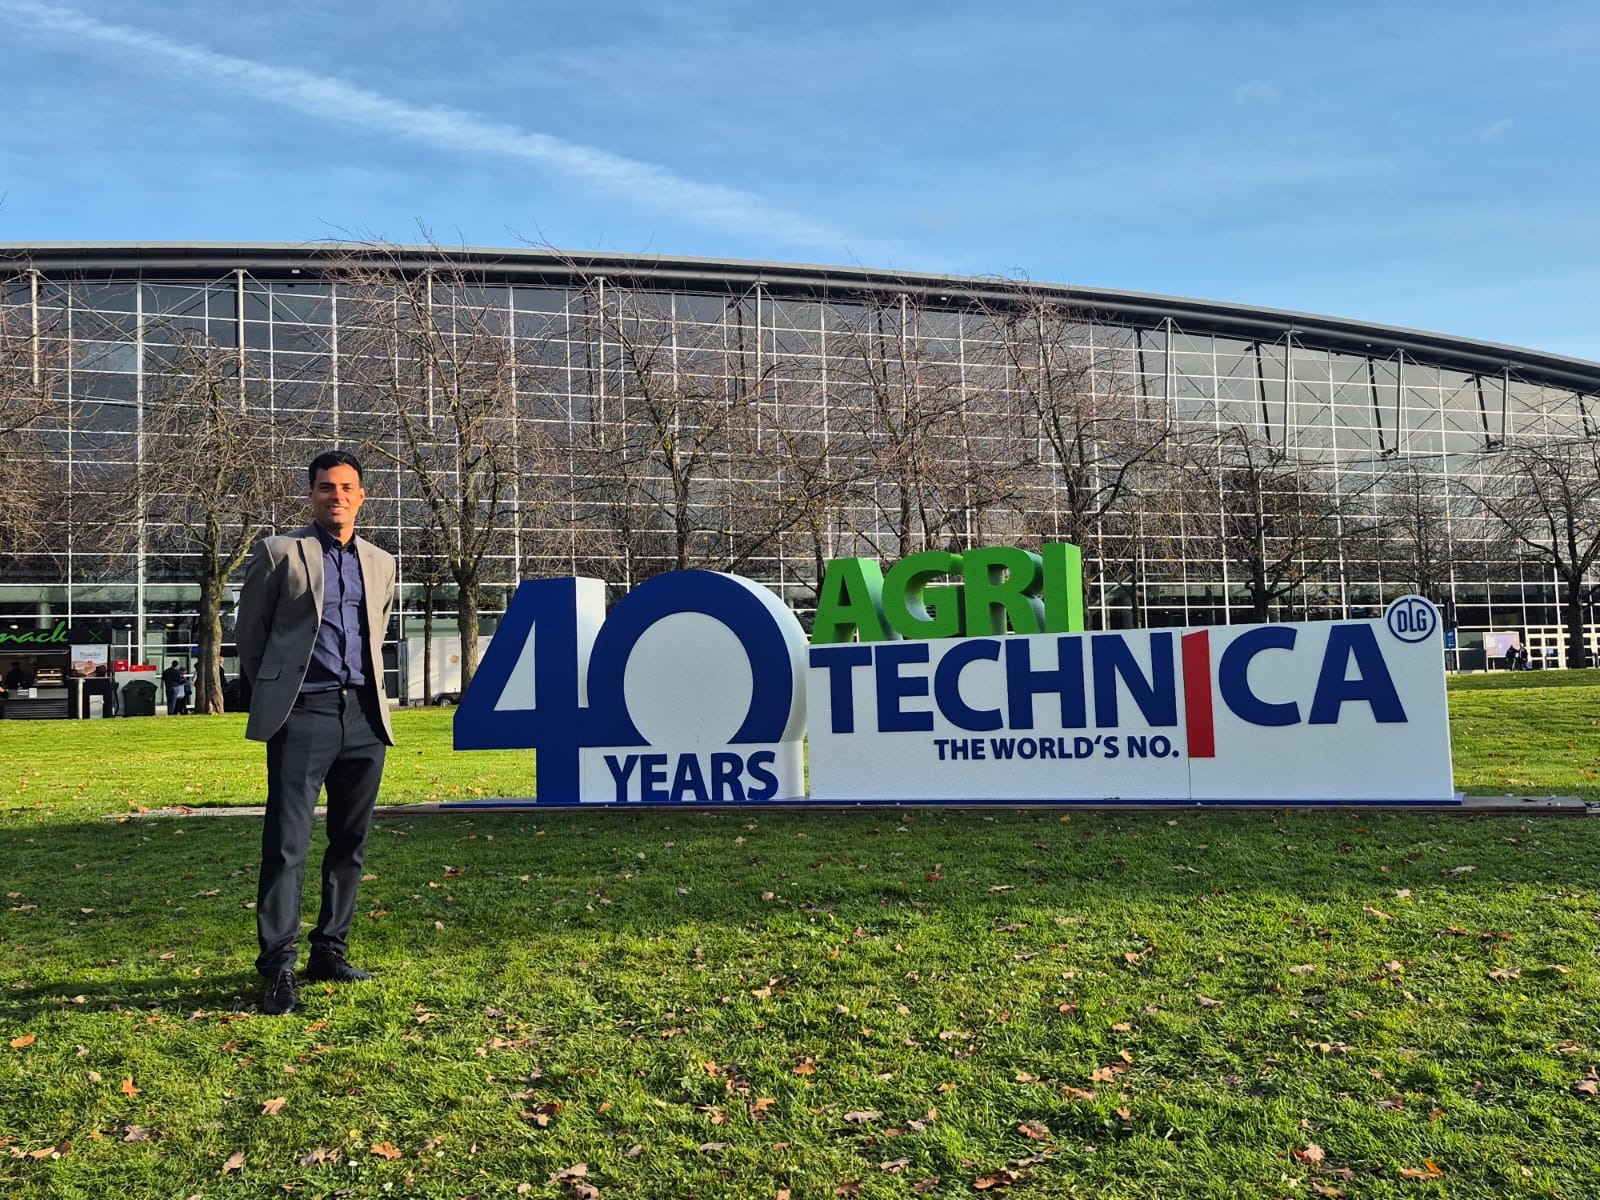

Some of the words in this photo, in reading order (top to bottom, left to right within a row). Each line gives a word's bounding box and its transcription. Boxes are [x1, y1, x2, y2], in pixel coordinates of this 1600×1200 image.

[811, 543, 1085, 644] AGRI
[0, 620, 69, 643] nack
[1396, 600, 1427, 633] DLG
[453, 569, 794, 804] 40
[933, 739, 986, 761] THE
[1127, 735, 1180, 759] NO.
[603, 750, 779, 802] YEARS
